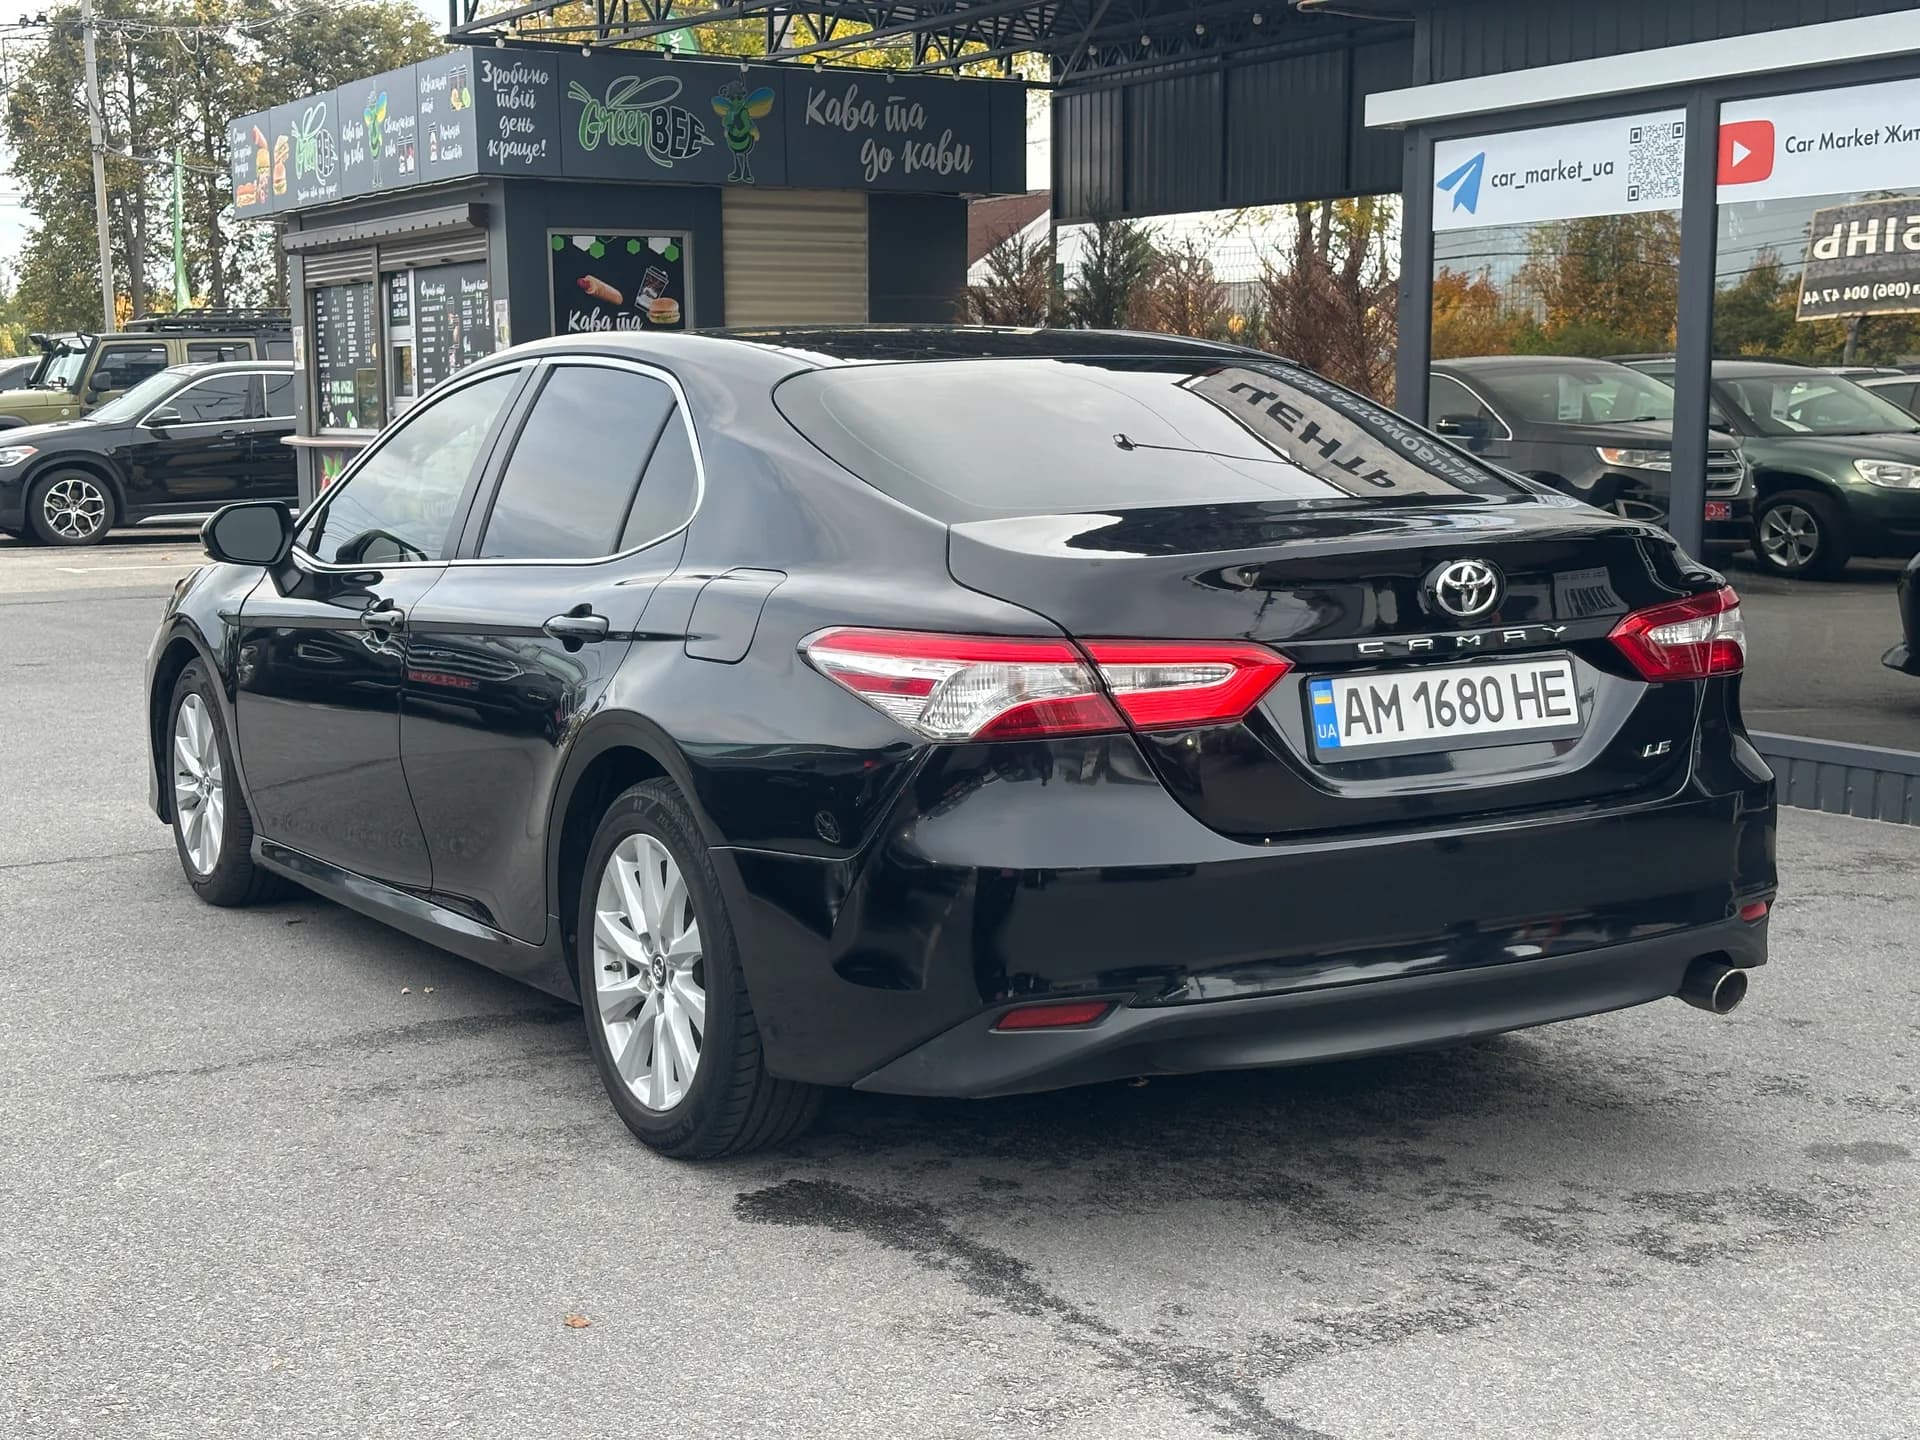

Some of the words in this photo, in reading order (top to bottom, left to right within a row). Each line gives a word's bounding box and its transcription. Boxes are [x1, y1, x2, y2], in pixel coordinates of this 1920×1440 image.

[481, 60, 549, 91] Зробимо
[496, 85, 537, 110] твій
[805, 83, 880, 132] Кава
[884, 95, 928, 132] та
[498, 114, 536, 138] день
[1785, 136, 1815, 153] Car
[1819, 128, 1880, 151] Market
[1884, 125, 1920, 144] Жит
[487, 139, 547, 166] краще!
[860, 138, 895, 183] до
[902, 128, 975, 176] кави
[1491, 160, 1614, 189] car_market_ua
[568, 306, 613, 332] Кава
[616, 311, 644, 332] та
[1357, 625, 1568, 654] CAMRY
[1317, 724, 1338, 739] UA
[1344, 684, 1404, 737] AM
[1412, 676, 1505, 729] 1680
[1510, 669, 1572, 720] HE
[1641, 739, 1672, 758] LE
